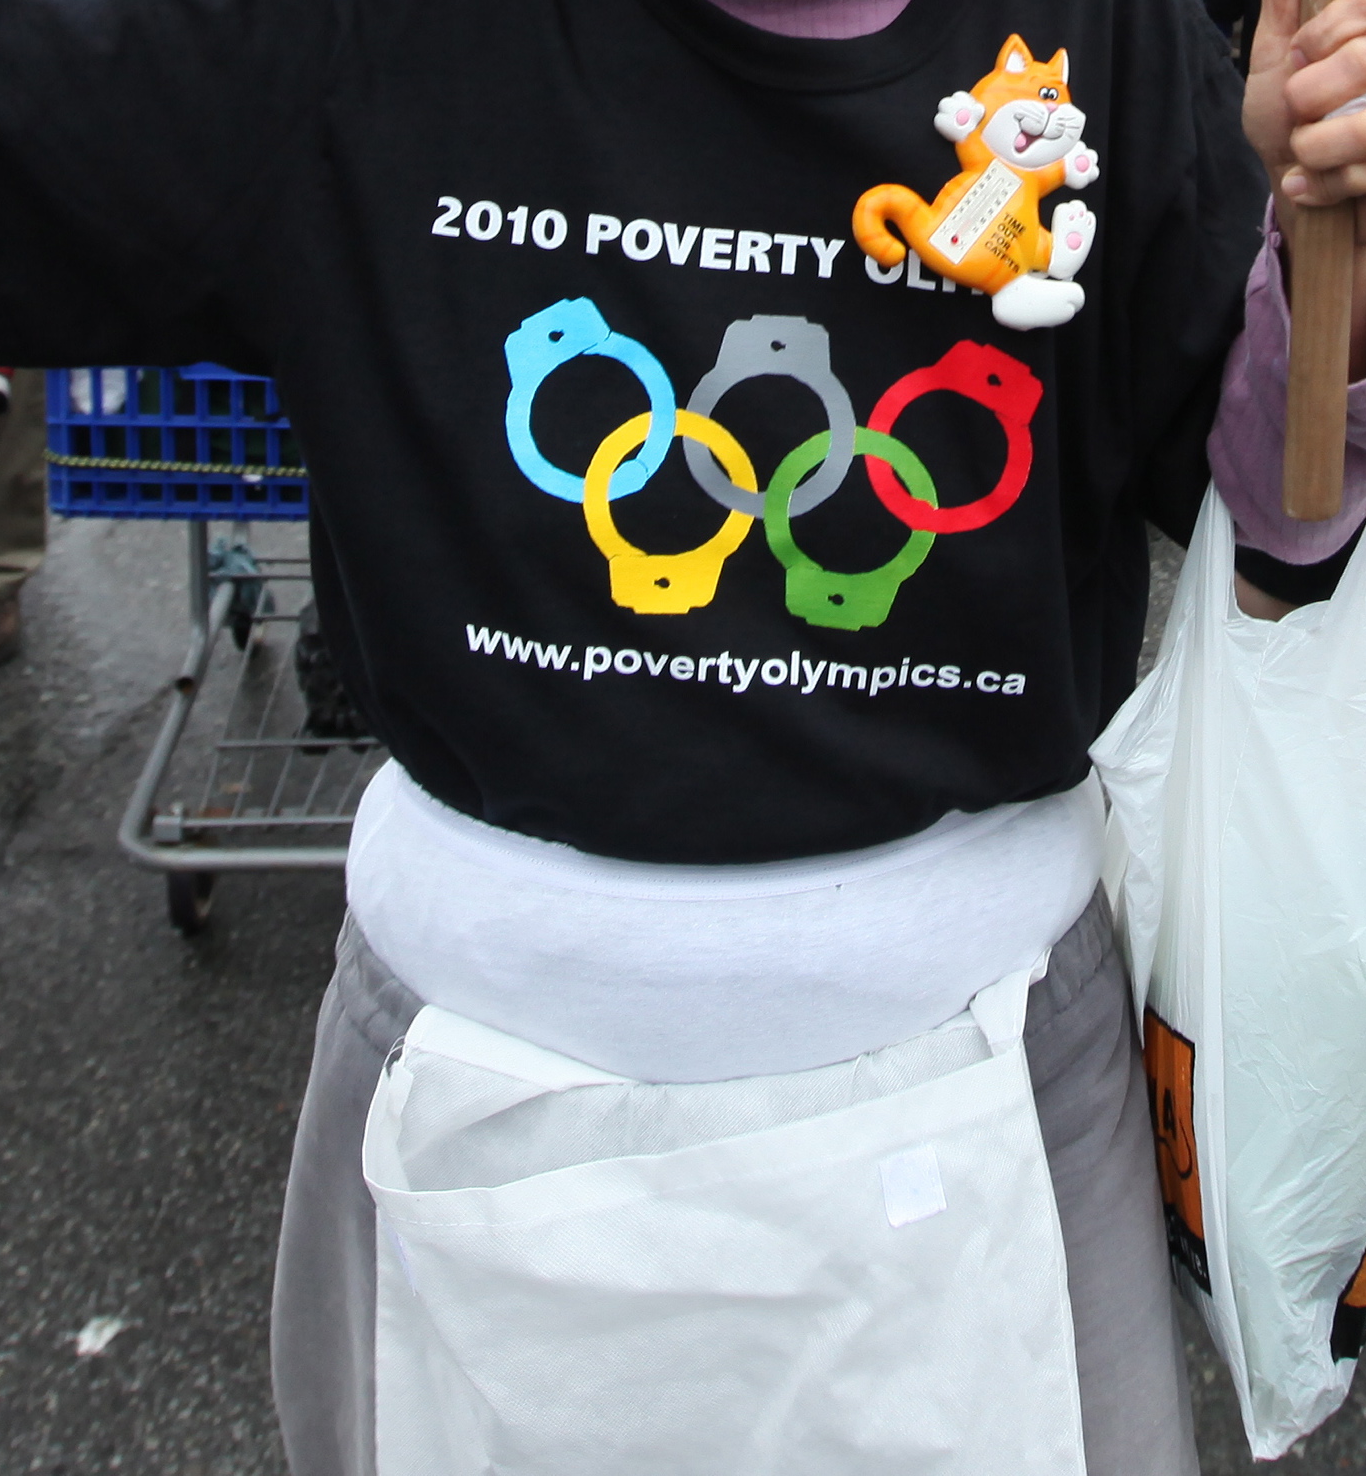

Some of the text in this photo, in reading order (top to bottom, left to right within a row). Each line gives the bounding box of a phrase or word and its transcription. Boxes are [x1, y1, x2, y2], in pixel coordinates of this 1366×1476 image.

[997, 223, 1018, 241] OUT
[1004, 212, 1026, 234] TIME
[431, 196, 568, 250] 2010
[586, 213, 846, 279] POVERTY
[991, 232, 1011, 251] FOR
[466, 624, 1027, 696] www.povertyolympics.ca
